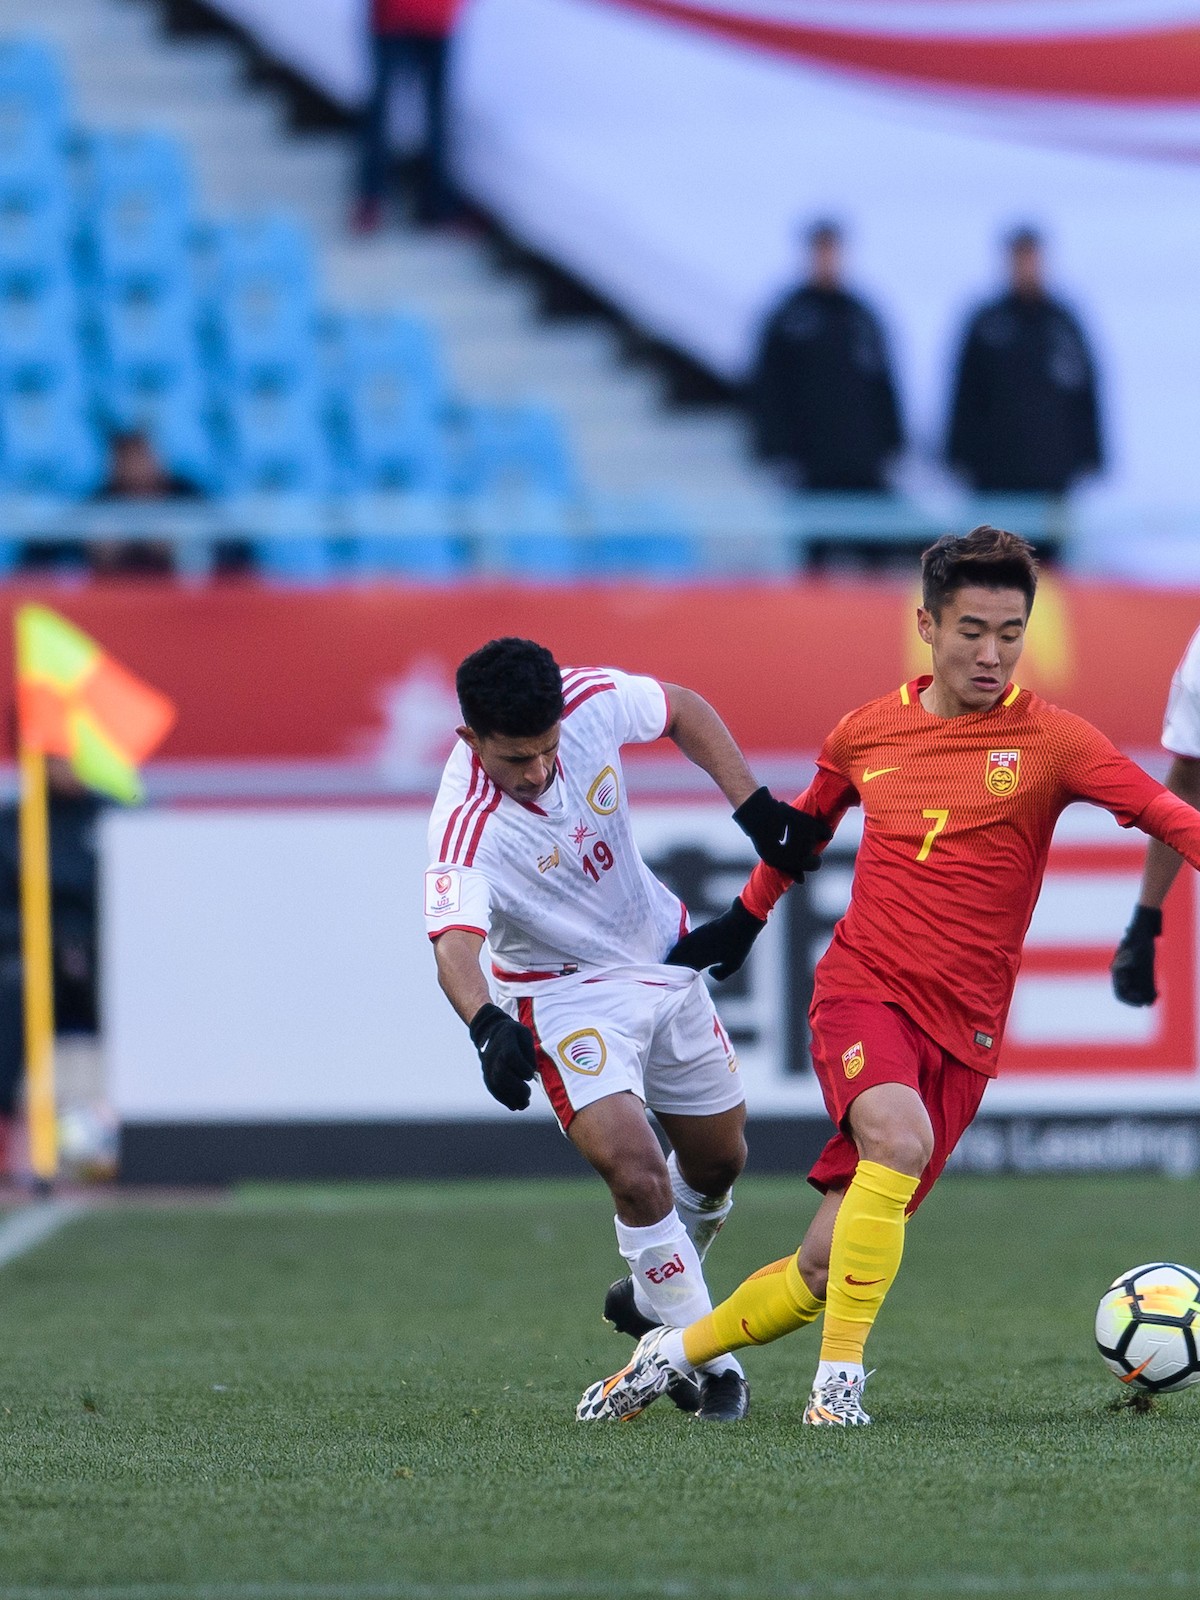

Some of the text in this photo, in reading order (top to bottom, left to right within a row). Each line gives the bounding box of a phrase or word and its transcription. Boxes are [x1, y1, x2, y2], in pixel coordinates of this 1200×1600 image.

[990, 752, 1018, 762] CFA
[916, 809, 949, 861] 7
[582, 841, 614, 883] 19
[1008, 1117, 1197, 1180] Leading
[645, 1253, 685, 1284] taj
